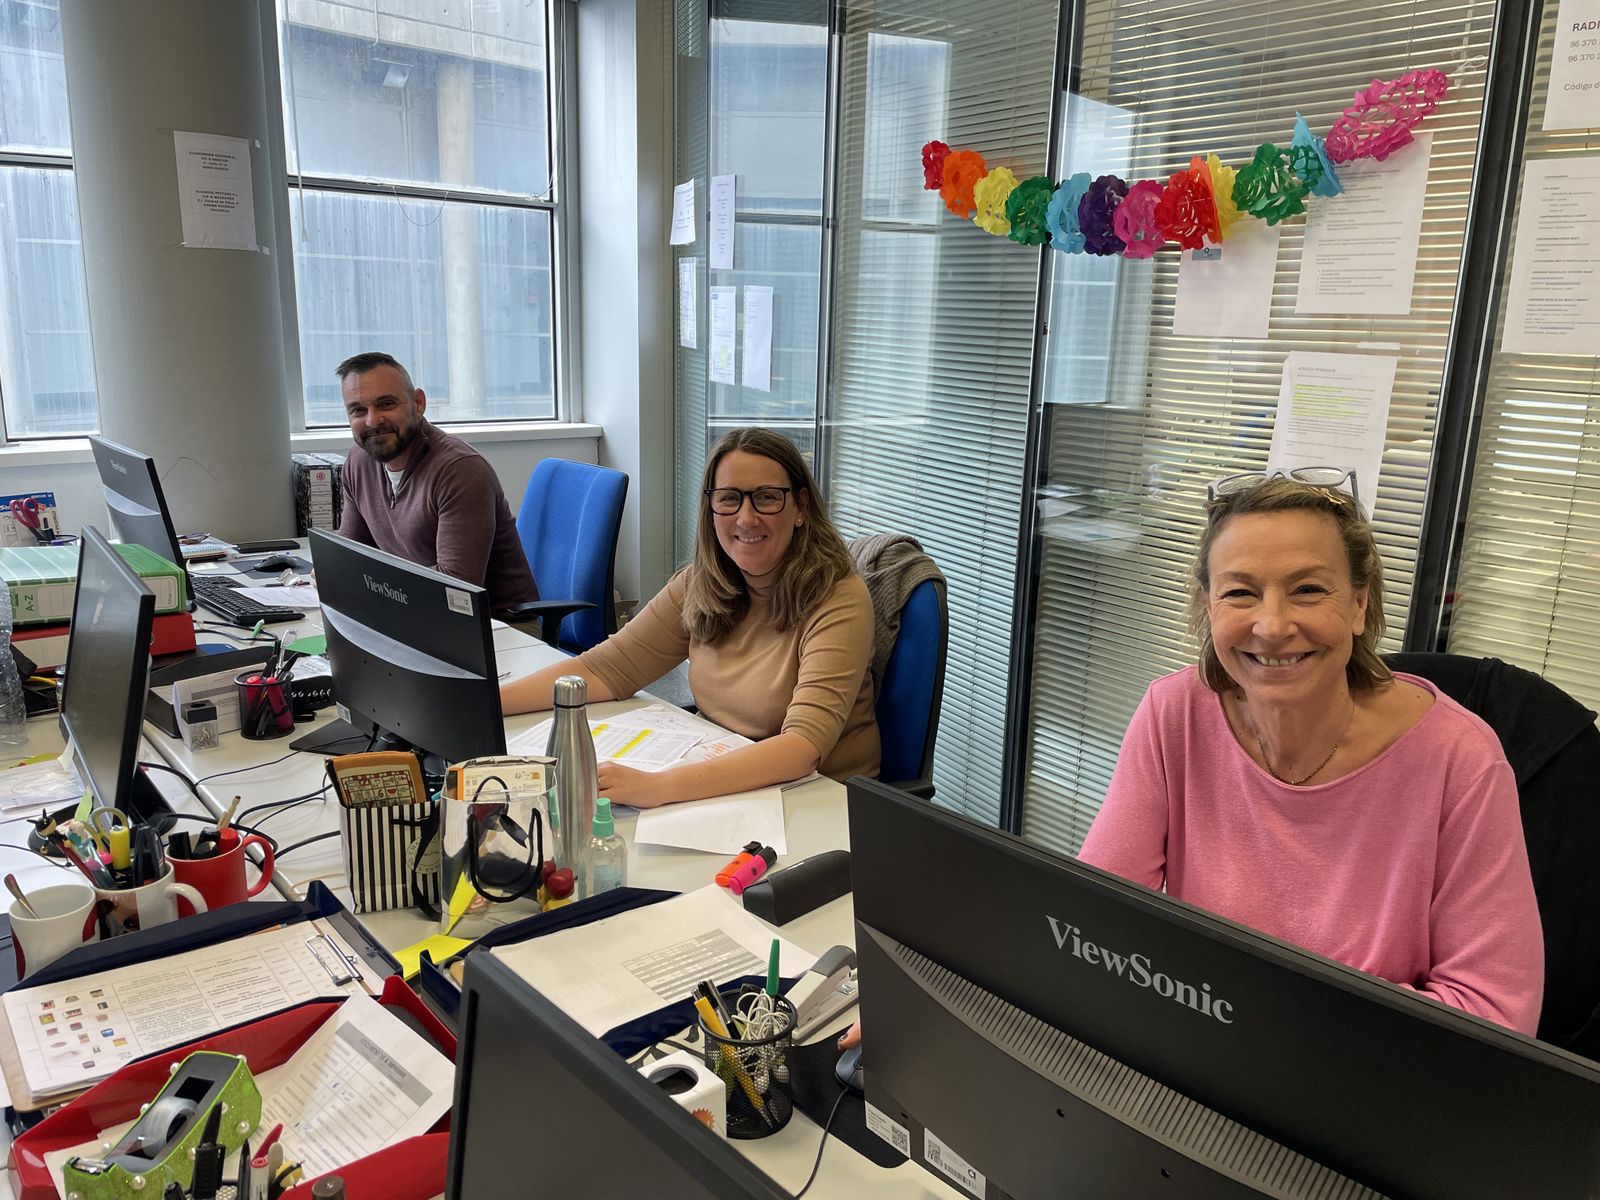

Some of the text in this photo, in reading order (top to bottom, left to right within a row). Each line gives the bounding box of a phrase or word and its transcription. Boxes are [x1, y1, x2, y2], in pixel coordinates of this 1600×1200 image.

[1581, 38, 1597, 47] 370
[1579, 53, 1595, 61] 370
[363, 574, 409, 605] ViewSonic
[24, 594, 34, 612] A-Z
[1045, 914, 1234, 1025] ViewSonic
